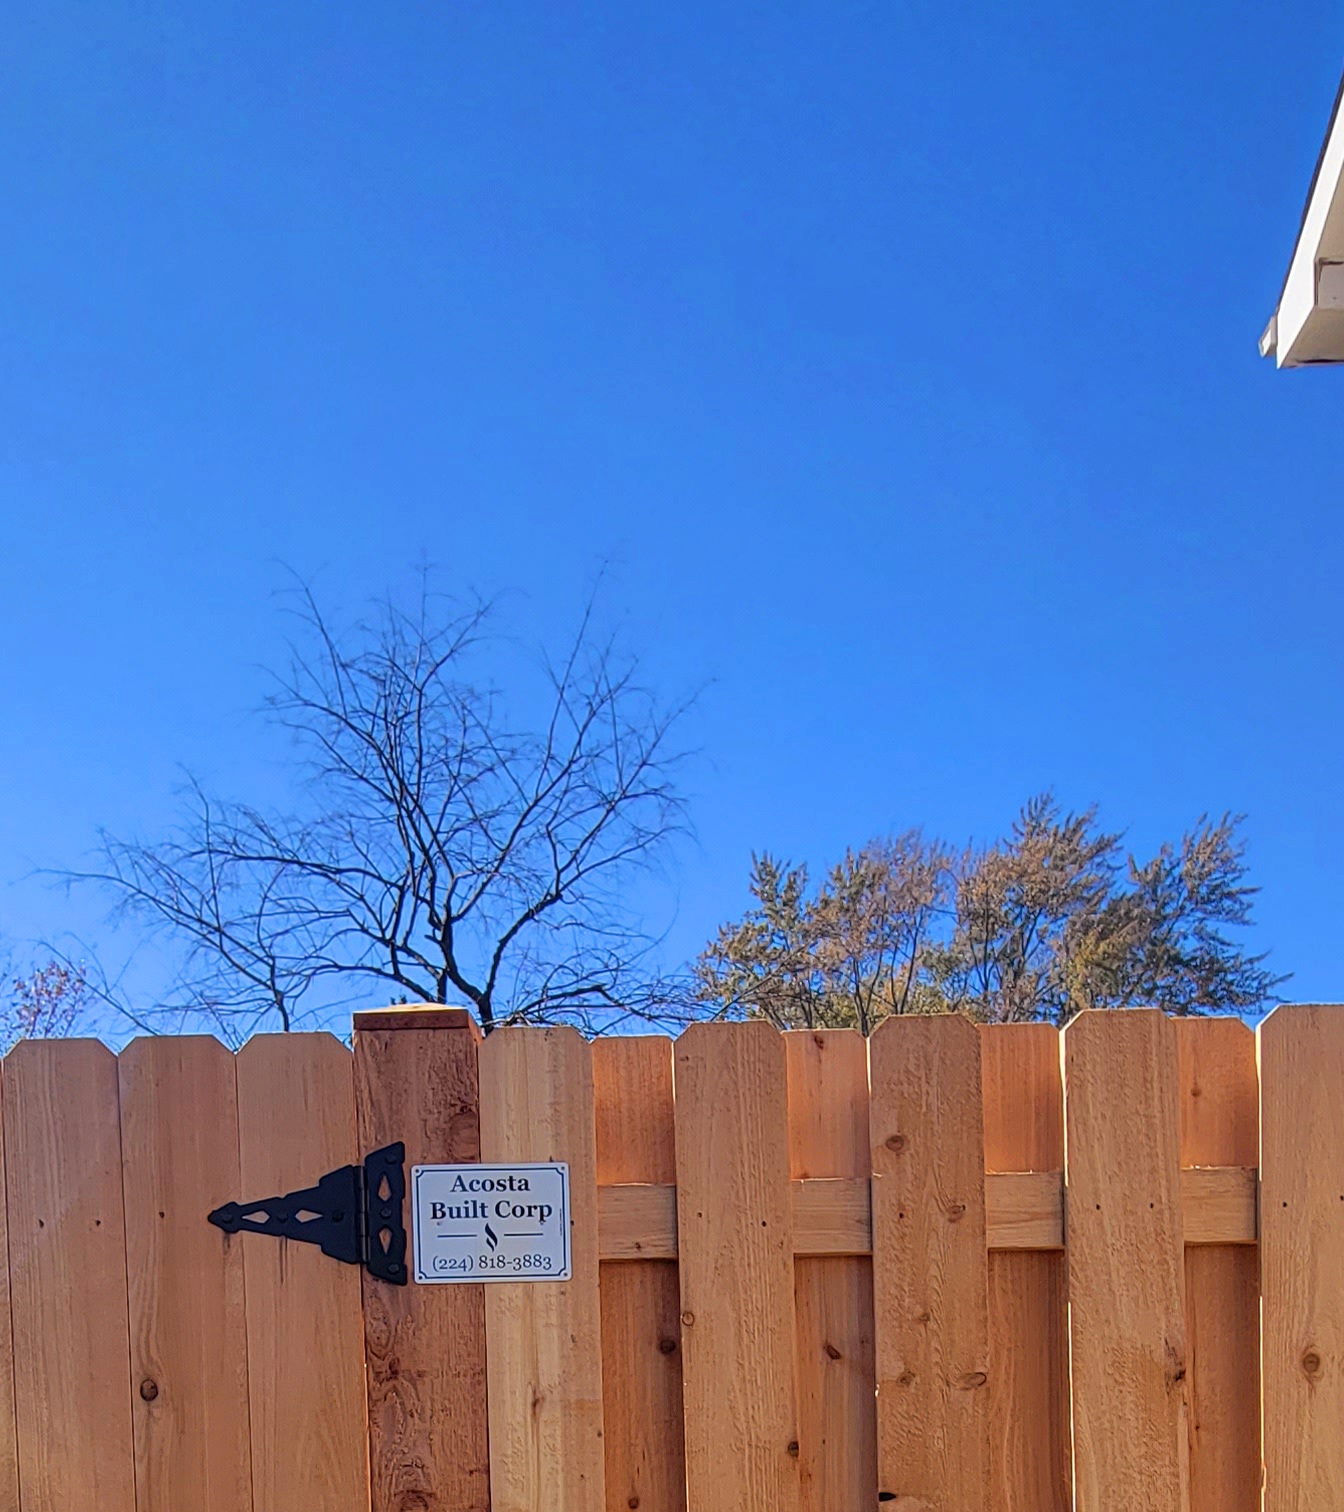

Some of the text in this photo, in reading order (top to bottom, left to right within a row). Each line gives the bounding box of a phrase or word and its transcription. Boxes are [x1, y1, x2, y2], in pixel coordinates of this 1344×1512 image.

[450, 1174, 531, 1193] Acosta
[430, 1200, 489, 1220] Built
[494, 1200, 553, 1223] Corp
[432, 1254, 552, 1272] (224) 818-3883
